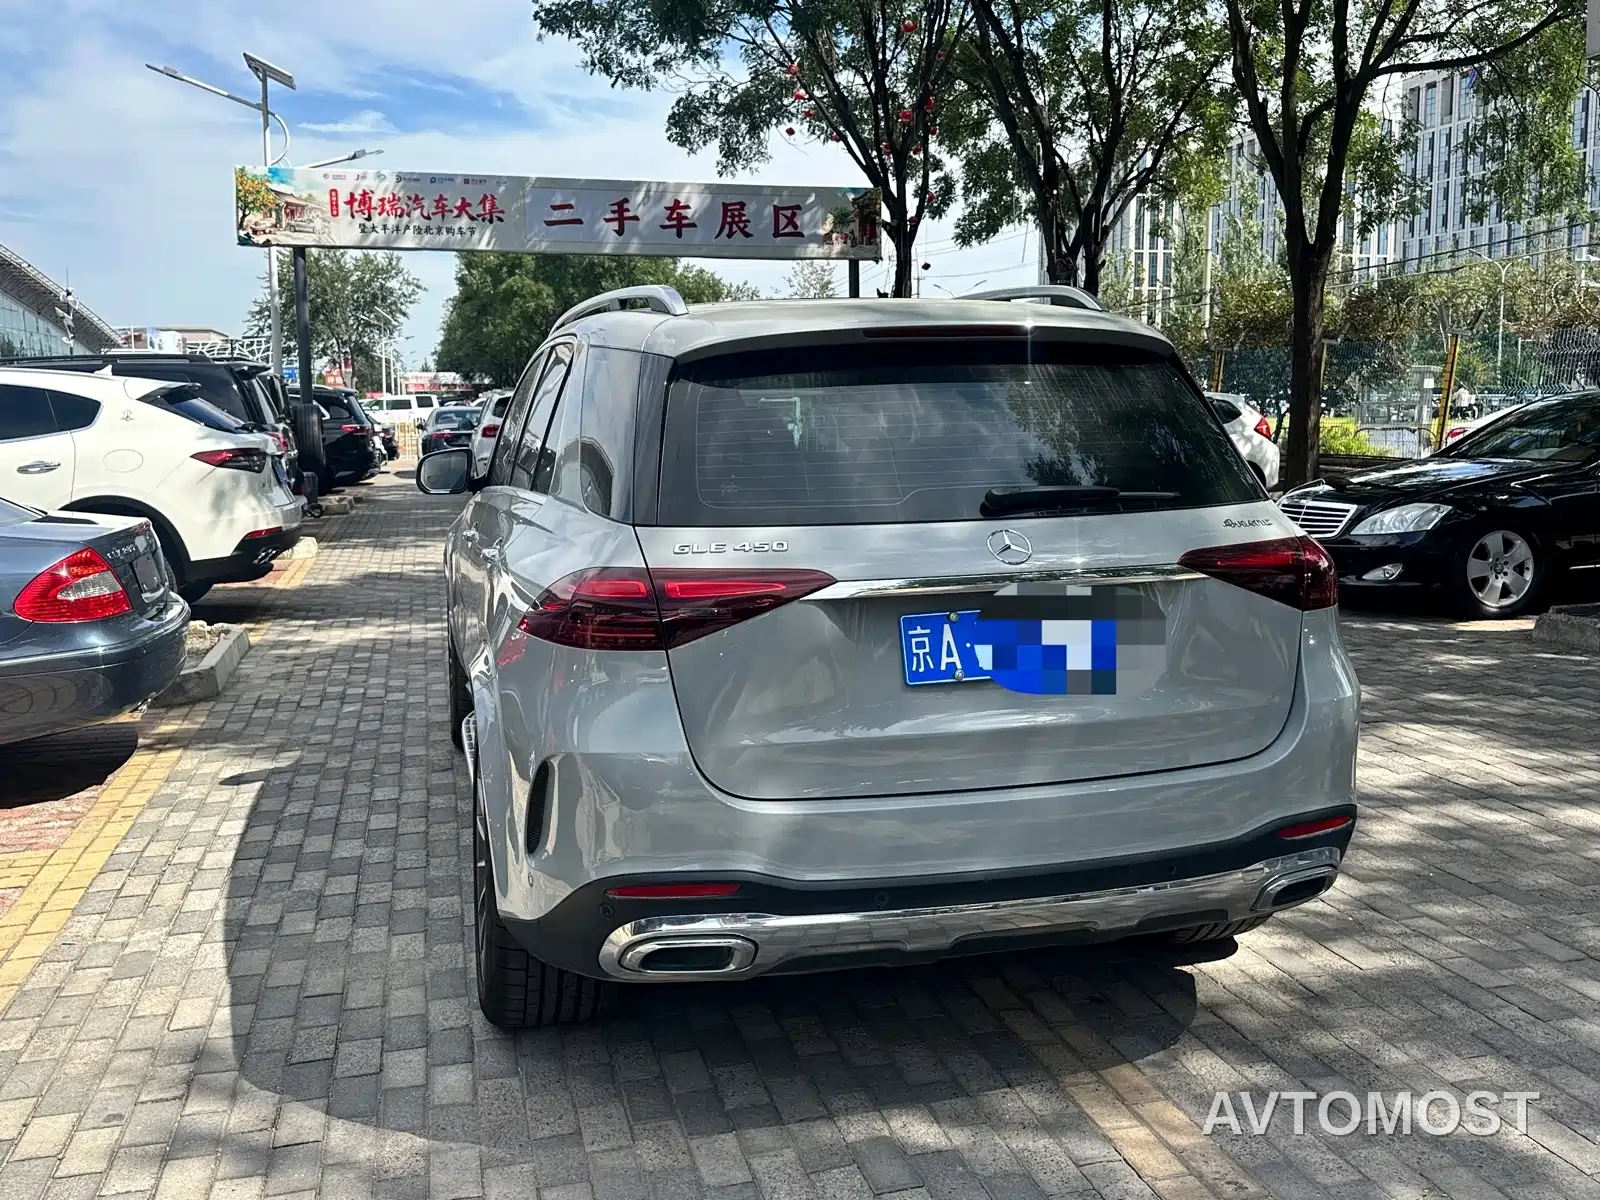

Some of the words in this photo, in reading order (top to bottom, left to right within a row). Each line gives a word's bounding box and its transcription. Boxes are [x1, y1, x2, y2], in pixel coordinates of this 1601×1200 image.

[344, 190, 506, 224] 博瑞汽车大集
[543, 197, 806, 240] 二手车展区
[358, 223, 477, 237] 暨太平洋产险北京购车节
[673, 542, 726, 554] GLE
[733, 540, 789, 553] 450
